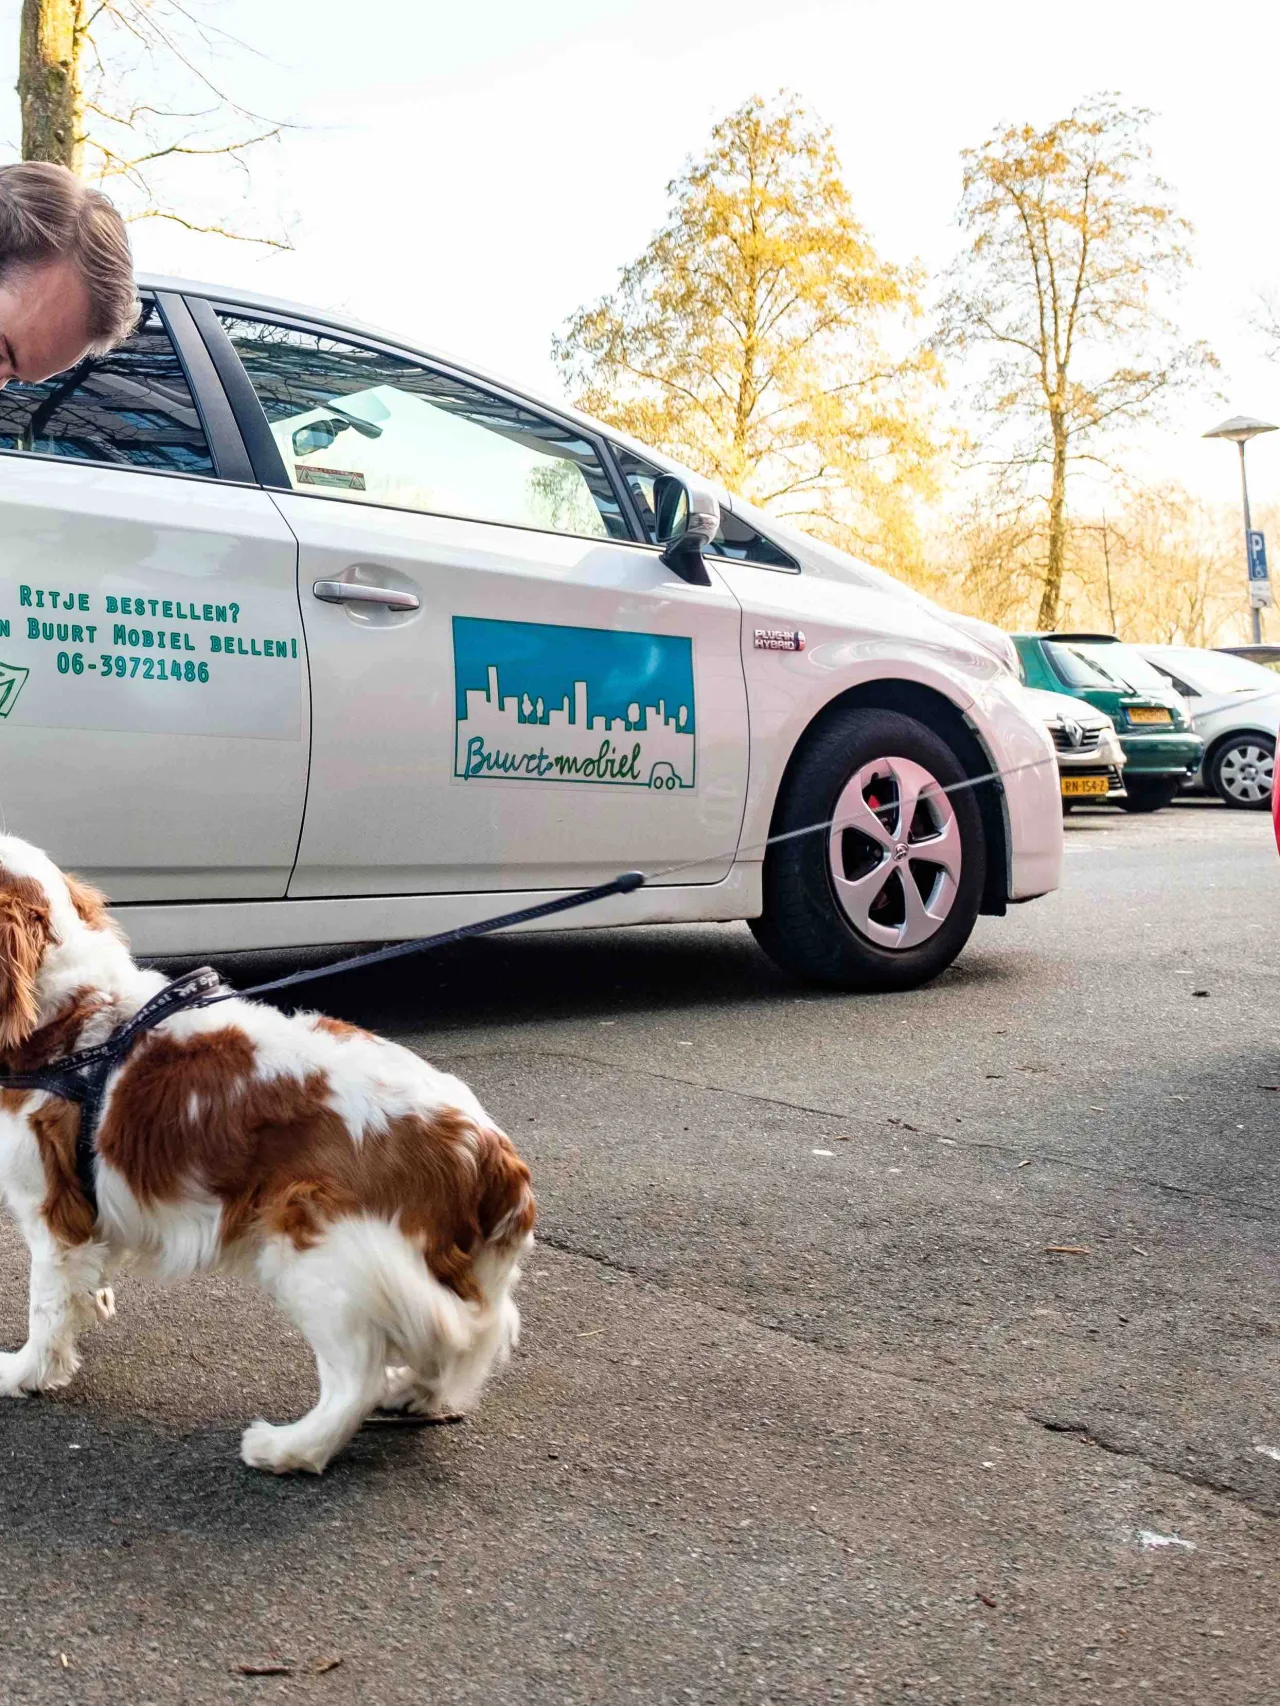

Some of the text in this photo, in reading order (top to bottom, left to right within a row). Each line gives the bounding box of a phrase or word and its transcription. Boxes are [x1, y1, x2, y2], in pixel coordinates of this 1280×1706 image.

[1251, 534, 1263, 560] P
[19, 584, 240, 623] RITJE BESTELLEN?
[27, 617, 97, 643] BUURT
[113, 624, 195, 650] MOBIEL
[210, 635, 297, 659] BELLEN!
[754, 639, 795, 650] HYBRID
[56, 651, 210, 683] 06-39721486
[1065, 780, 1105, 793] RN-154-Z
